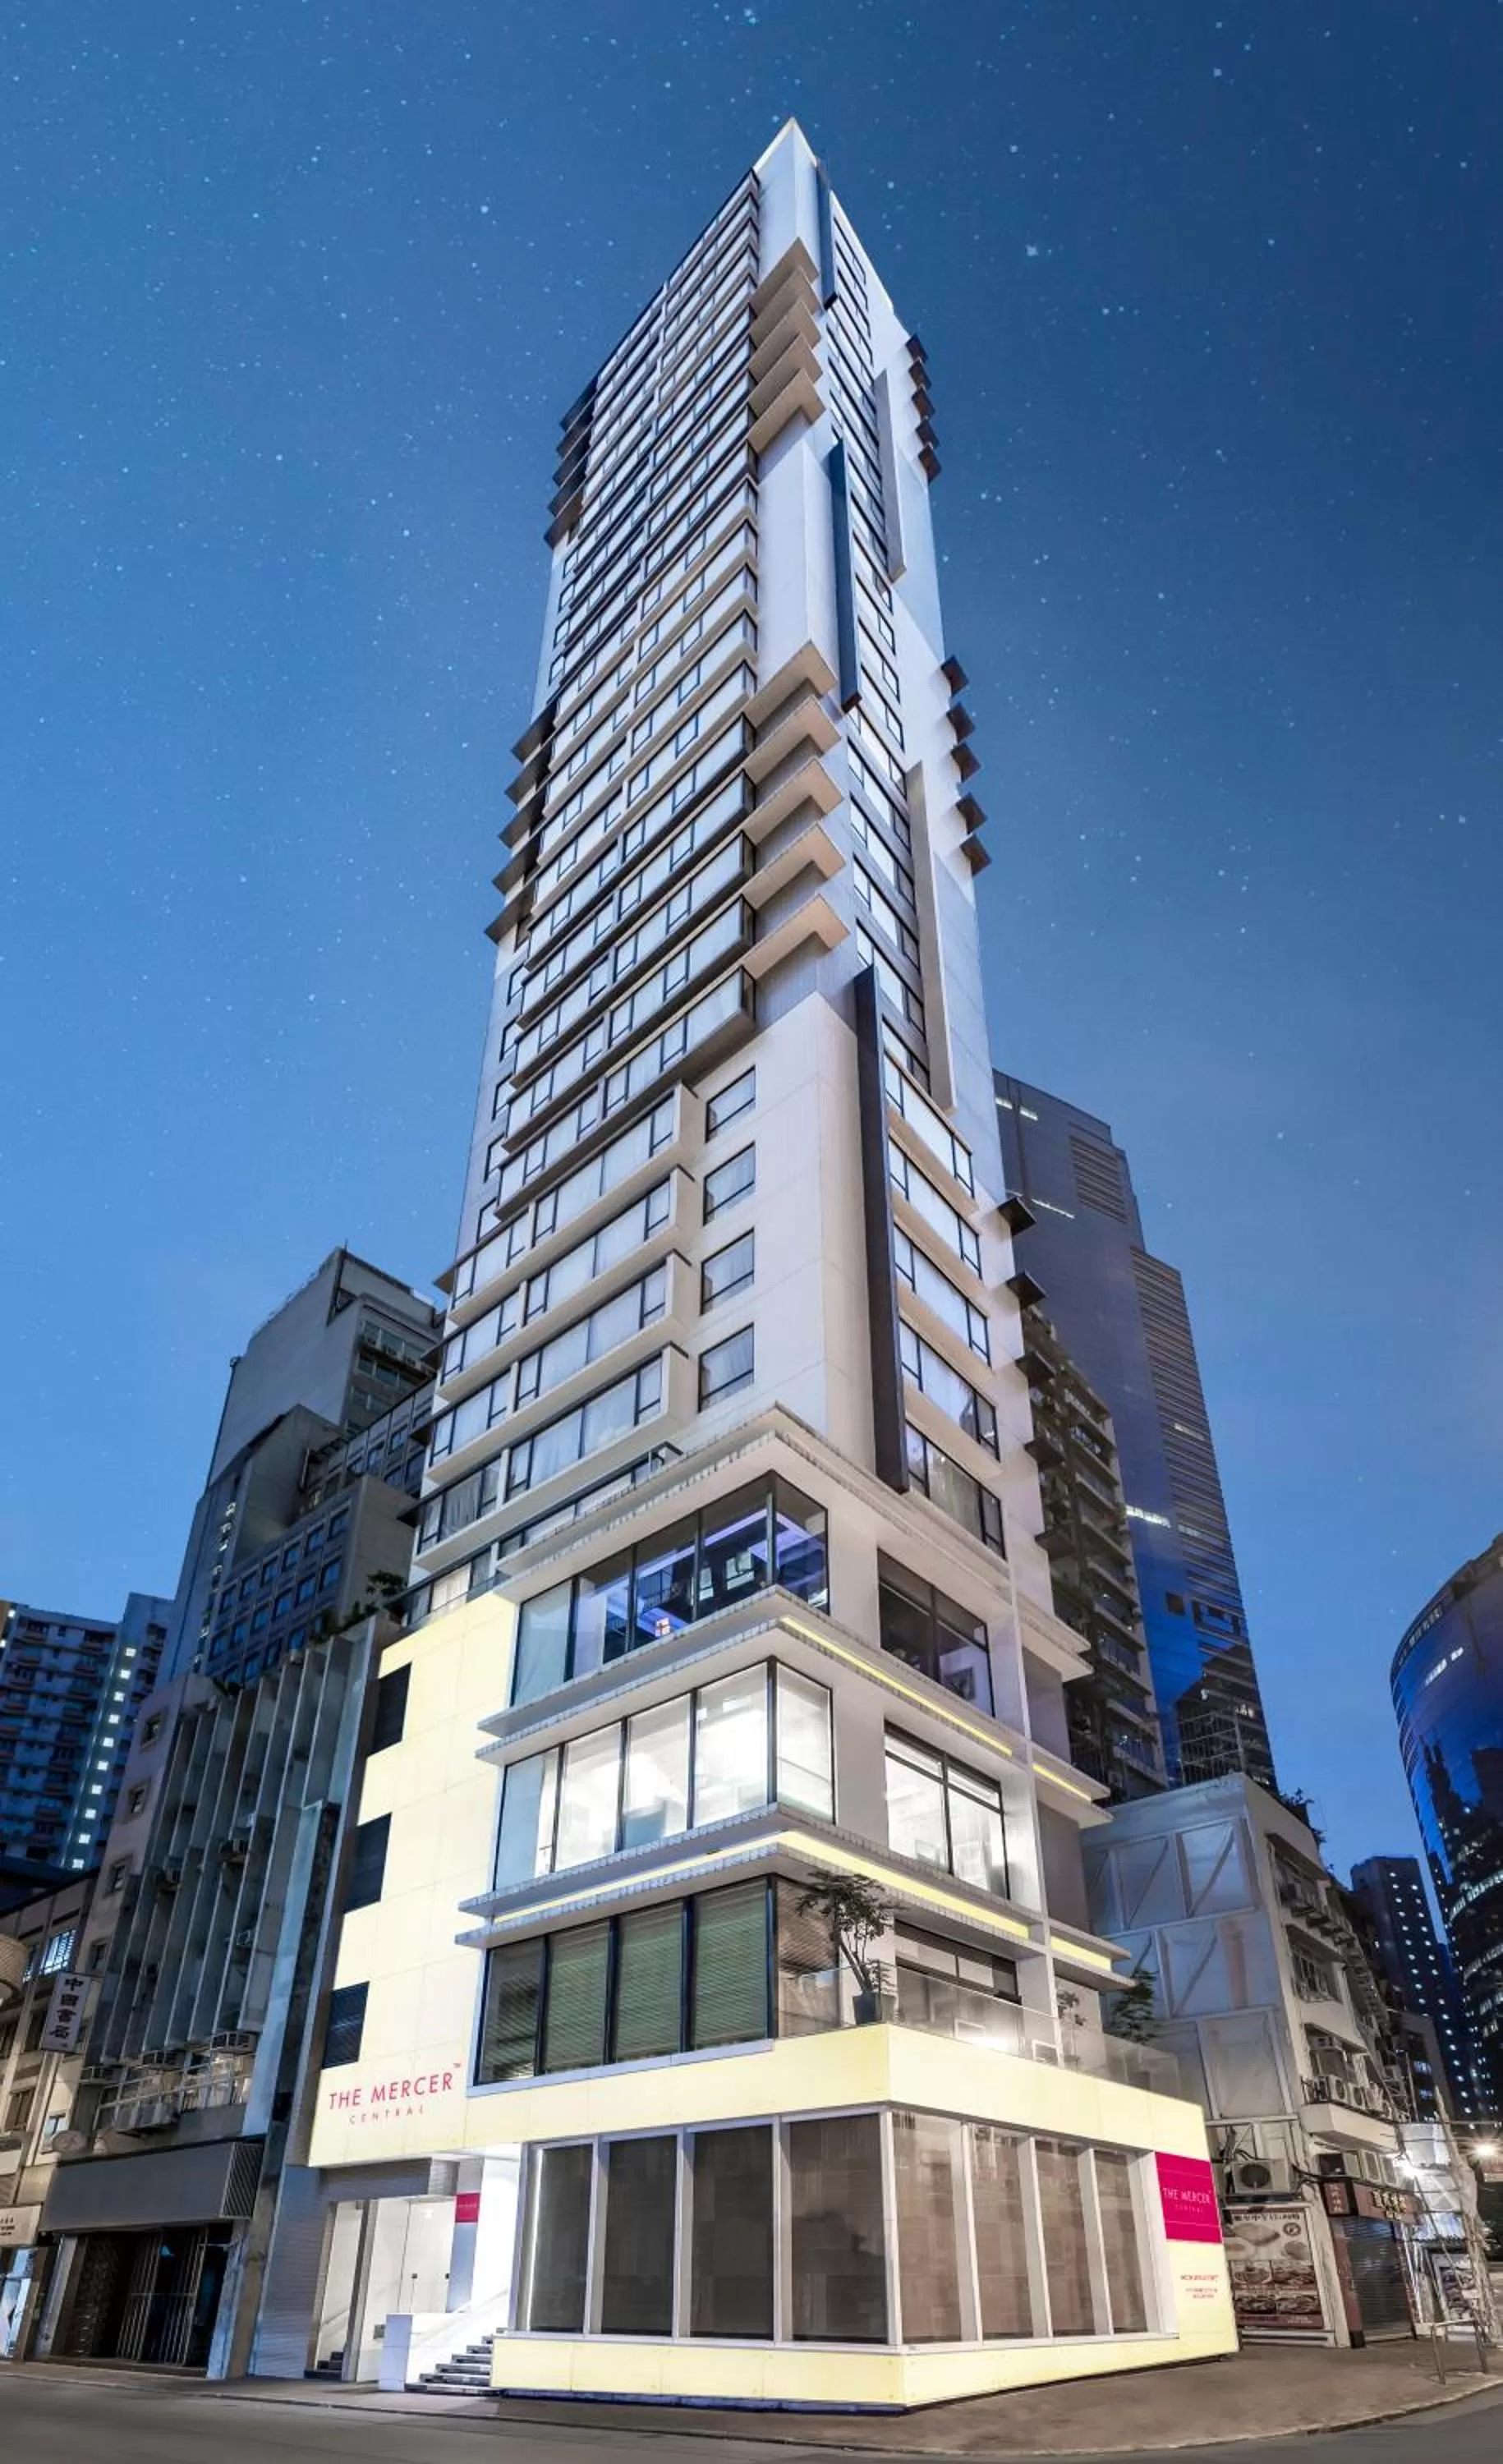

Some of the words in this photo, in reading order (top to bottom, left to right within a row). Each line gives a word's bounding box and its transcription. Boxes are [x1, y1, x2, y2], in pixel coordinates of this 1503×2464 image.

[329, 2089, 362, 2110] THE
[370, 2072, 453, 2103] MERCER
[348, 2104, 424, 2126] CENTRAL
[1162, 2187, 1179, 2200] THE
